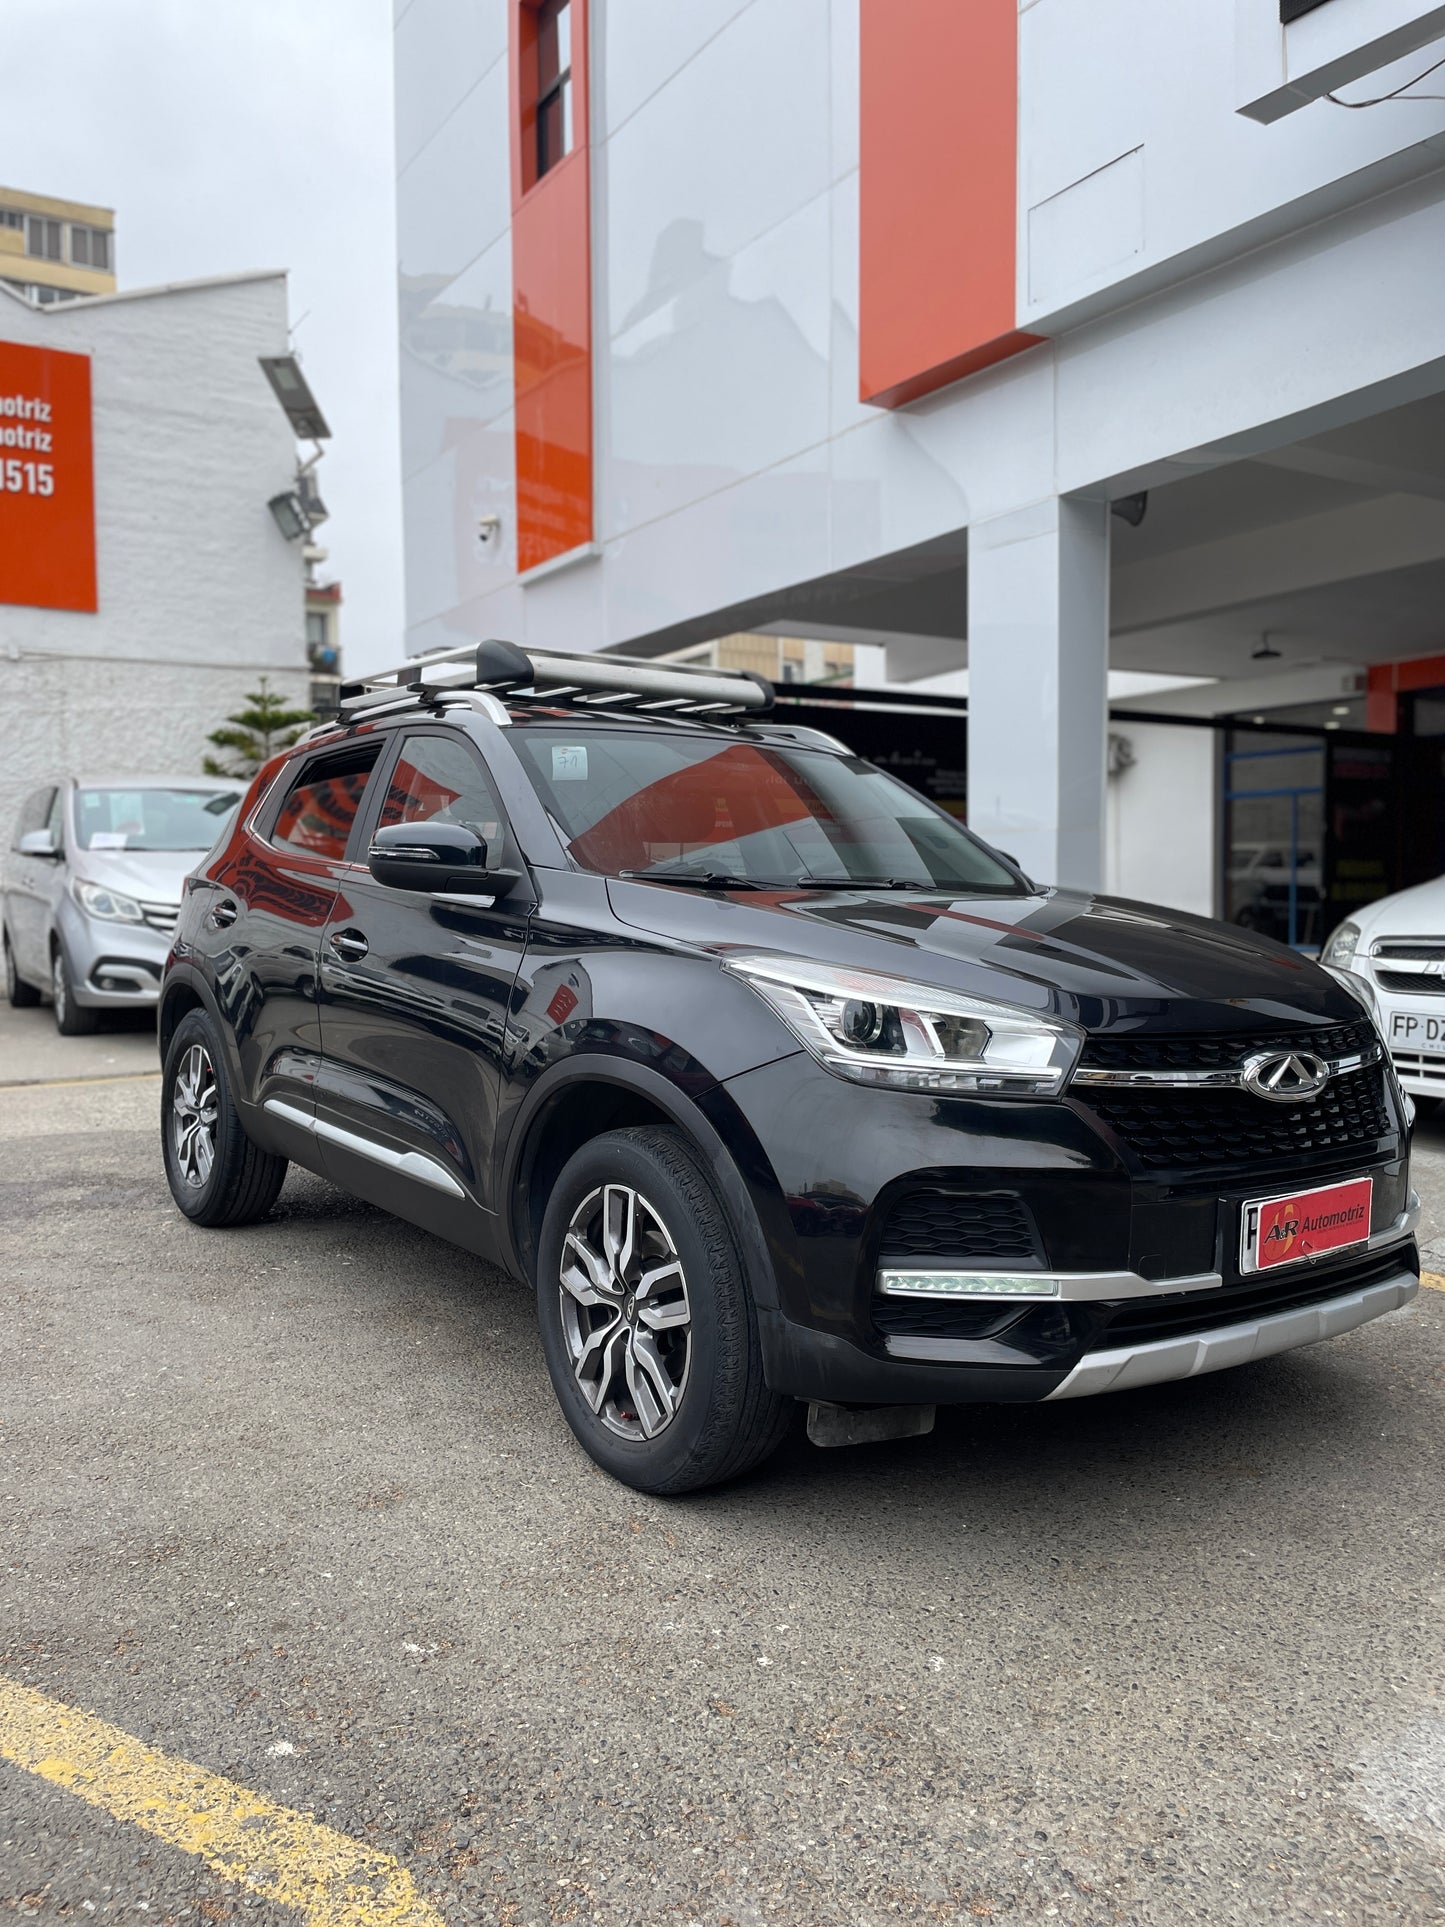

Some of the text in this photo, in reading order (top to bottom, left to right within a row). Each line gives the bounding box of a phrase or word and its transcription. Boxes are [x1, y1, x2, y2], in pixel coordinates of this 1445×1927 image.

[0, 394, 51, 422] otriz
[0, 425, 52, 453] otriz
[1264, 1219, 1299, 1244] A&R
[1301, 1204, 1365, 1234] Automotriz
